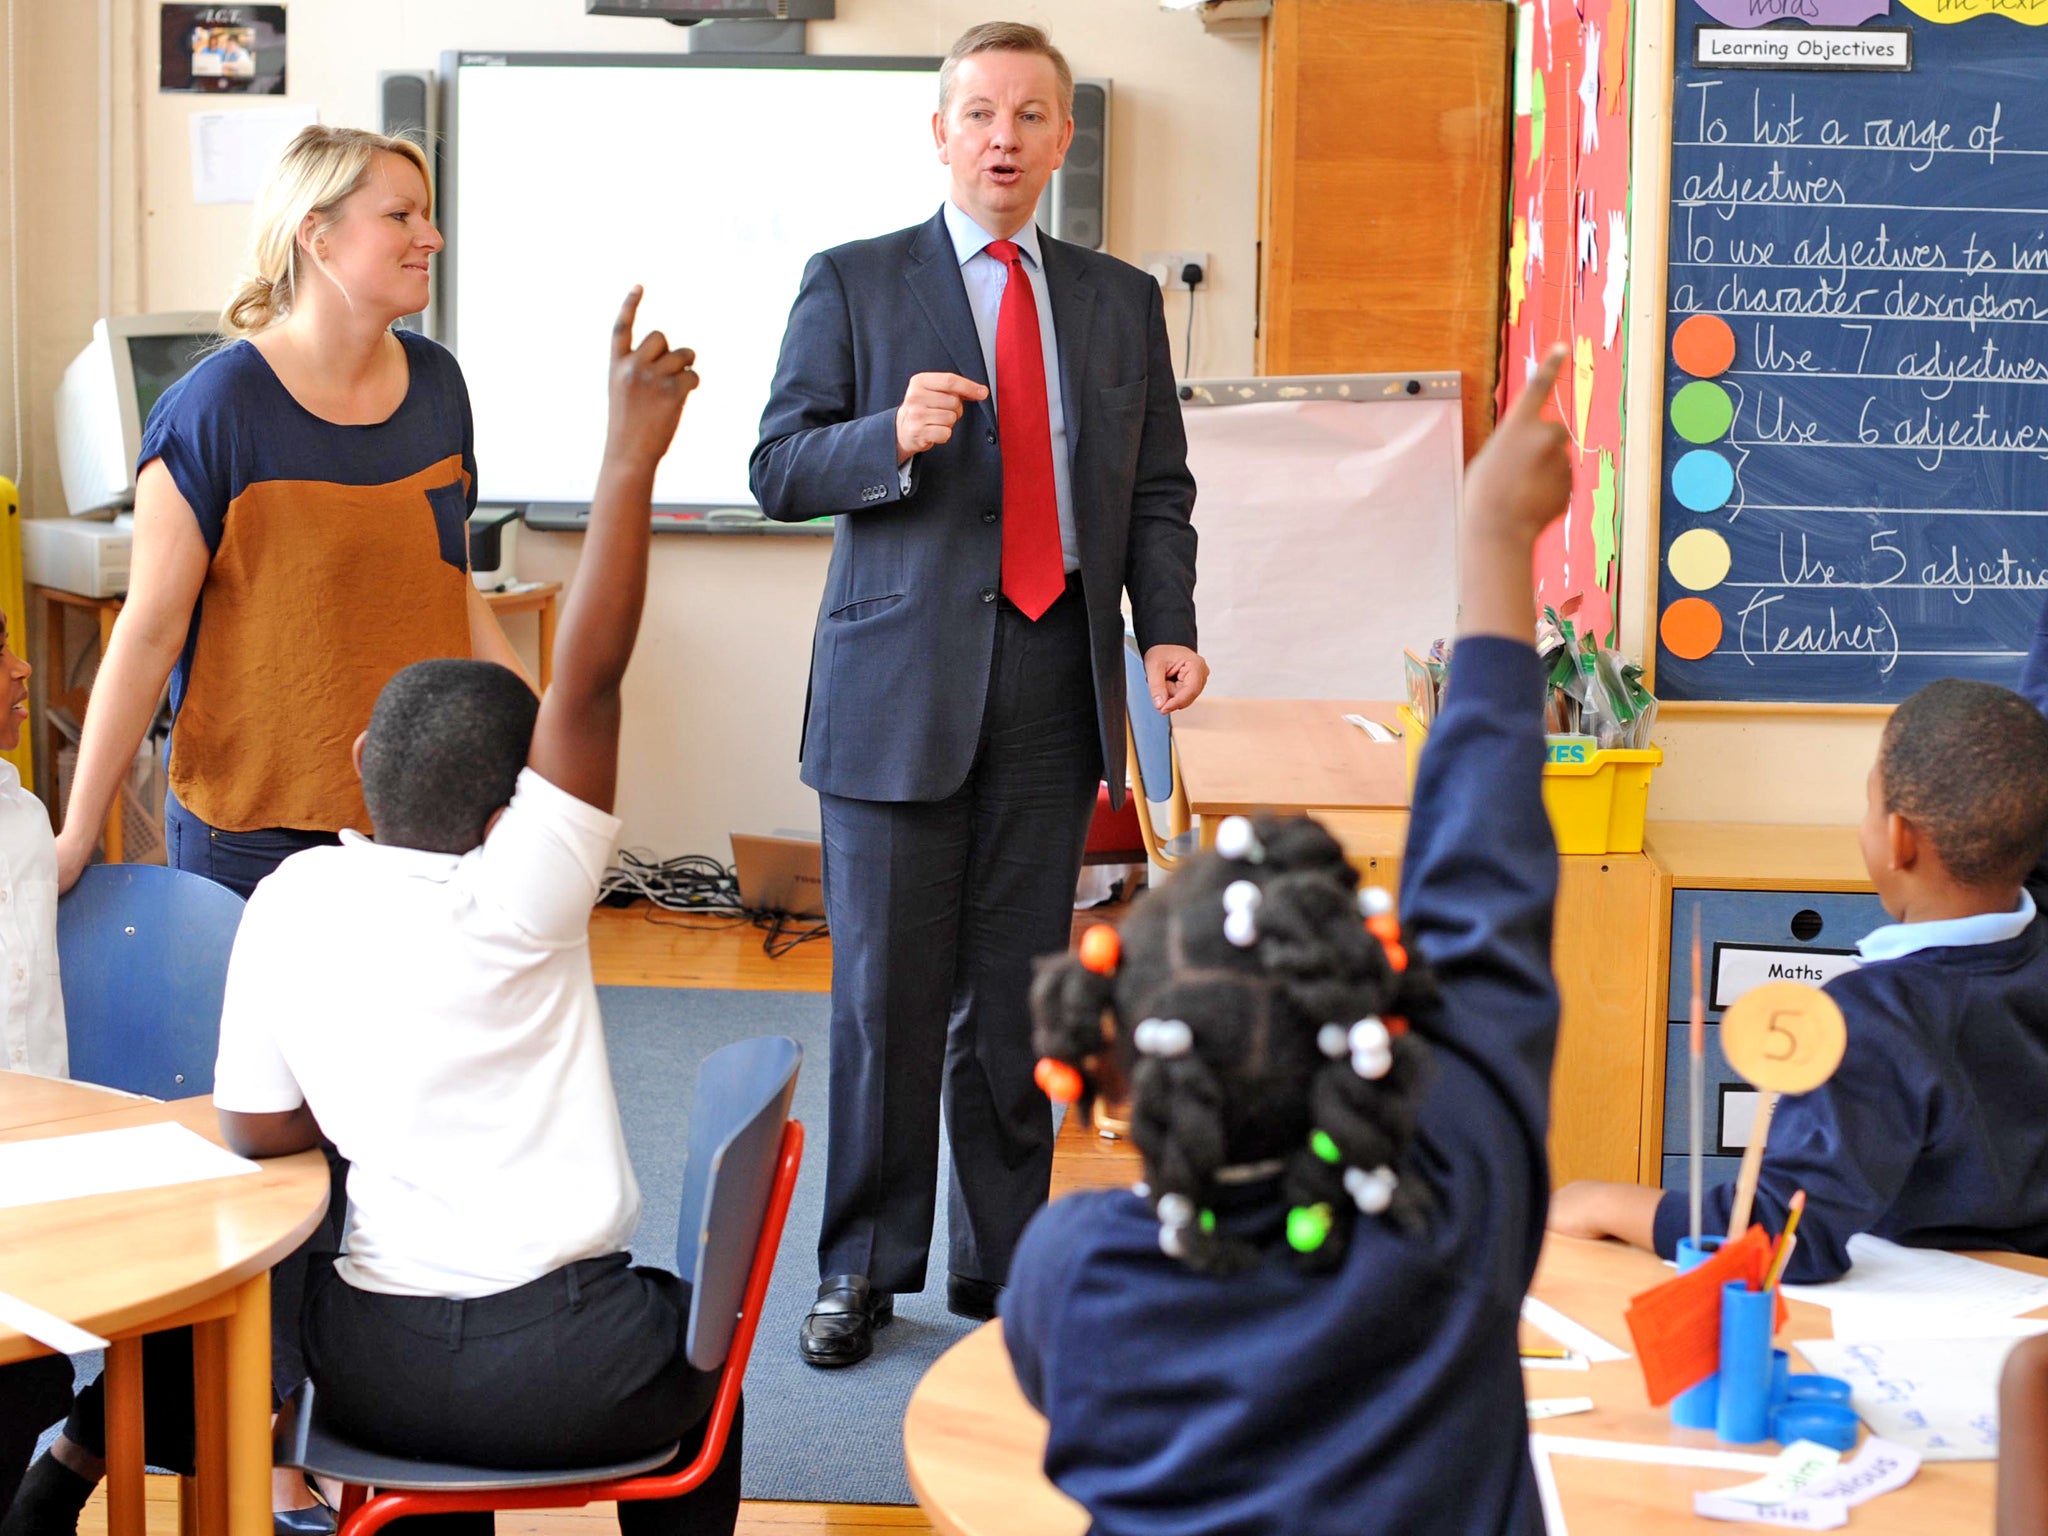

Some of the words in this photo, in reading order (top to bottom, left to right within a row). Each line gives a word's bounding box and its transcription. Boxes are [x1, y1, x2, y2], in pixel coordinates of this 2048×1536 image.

[1711, 39, 1789, 61] Learning
[1796, 40, 1895, 60] Objectives
[1687, 80, 1728, 143] To
[1753, 87, 1805, 145] list
[1820, 119, 1850, 145] a
[1864, 119, 1955, 172] range
[1968, 101, 2005, 164] of
[1683, 162, 1846, 221] adjectives
[1678, 202, 1715, 262] To
[1730, 240, 1775, 266] use
[1793, 222, 1947, 293] adjectives
[1962, 231, 1997, 276] to
[1673, 284, 1703, 312] a
[1717, 273, 1880, 317] character
[1884, 278, 2048, 333] description
[1755, 322, 1821, 373] Use
[1840, 323, 1873, 374] 7
[1755, 390, 1830, 445] Use
[1858, 396, 1879, 444] 6
[1780, 531, 1841, 587] Use
[1870, 529, 1907, 589] 5
[1737, 588, 1899, 674] (Teacher)
[1767, 963, 1823, 981] Maths
[1763, 1009, 1804, 1062] 5
